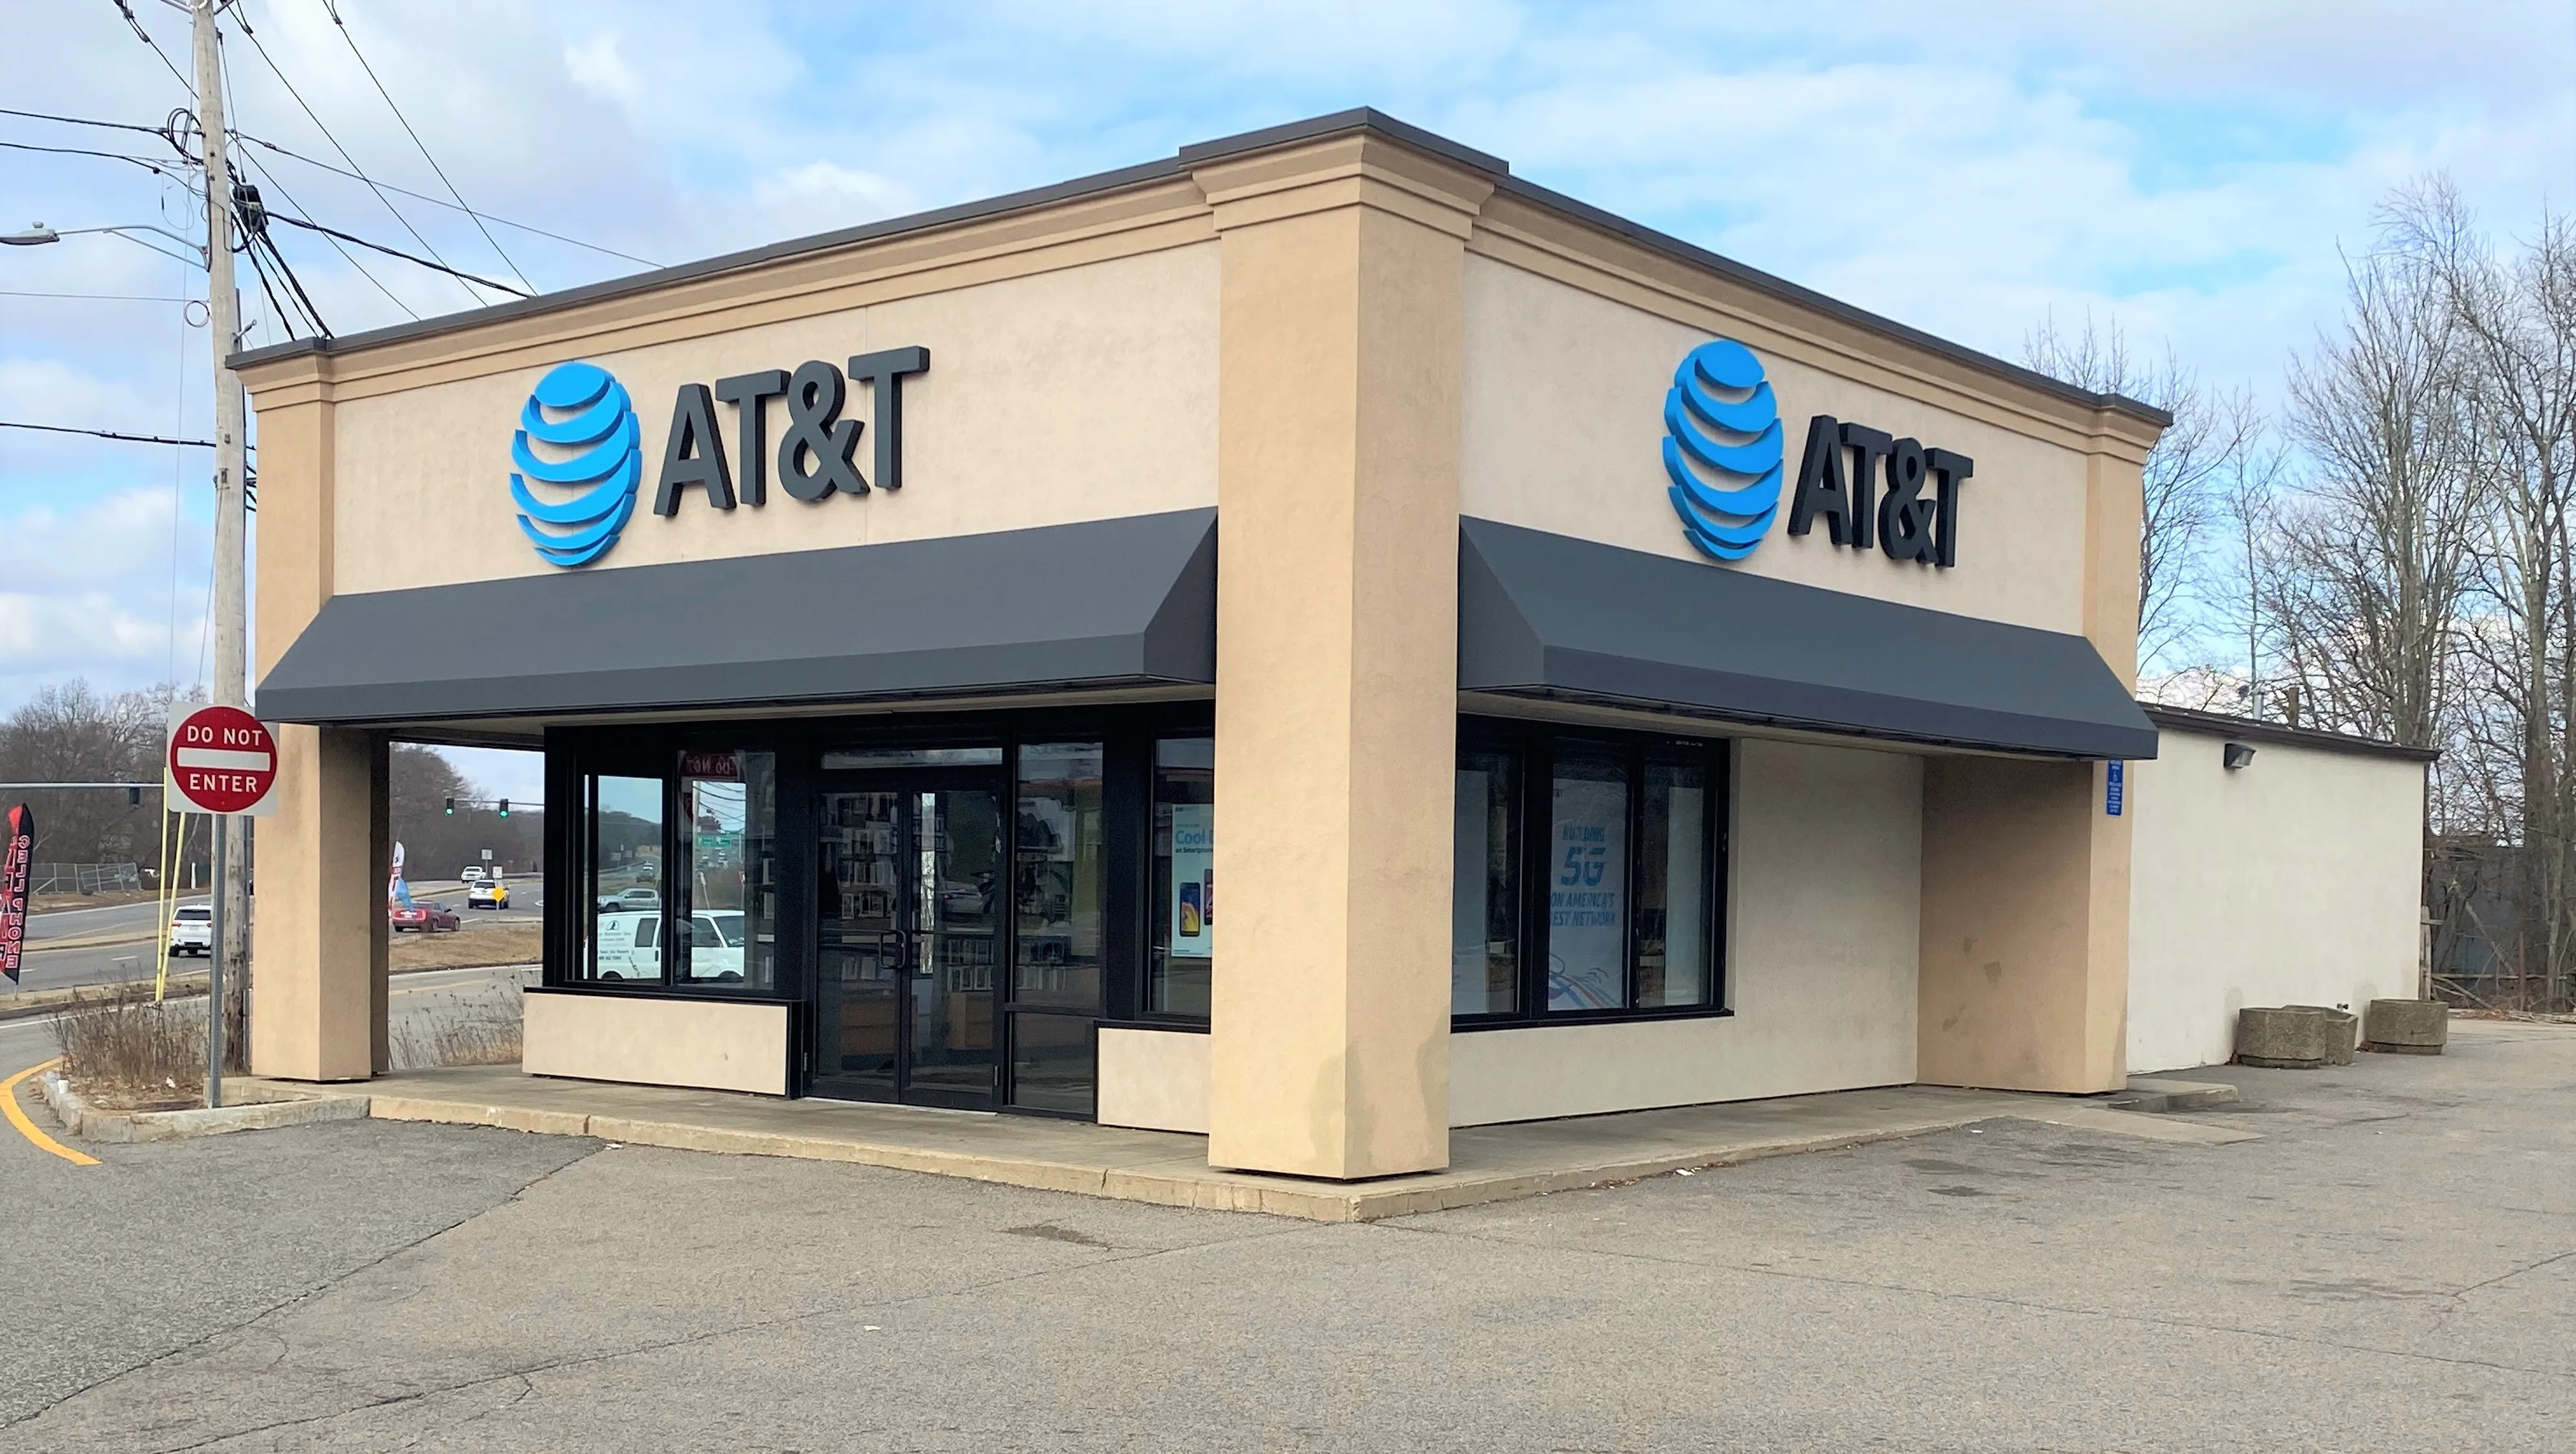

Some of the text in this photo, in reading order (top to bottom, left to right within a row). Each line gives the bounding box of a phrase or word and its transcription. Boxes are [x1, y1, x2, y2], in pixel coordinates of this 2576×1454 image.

[654, 345, 930, 517] AT&T
[1788, 415, 1973, 568] AT&T
[187, 725, 262, 746] DO NOT
[190, 774, 257, 792] ENTER
[1176, 829, 1204, 844] Cool
[1561, 846, 1606, 886] 5G
[1551, 892, 1615, 908] ON AMERICA'S
[1552, 910, 1616, 927] EST NETWORK
